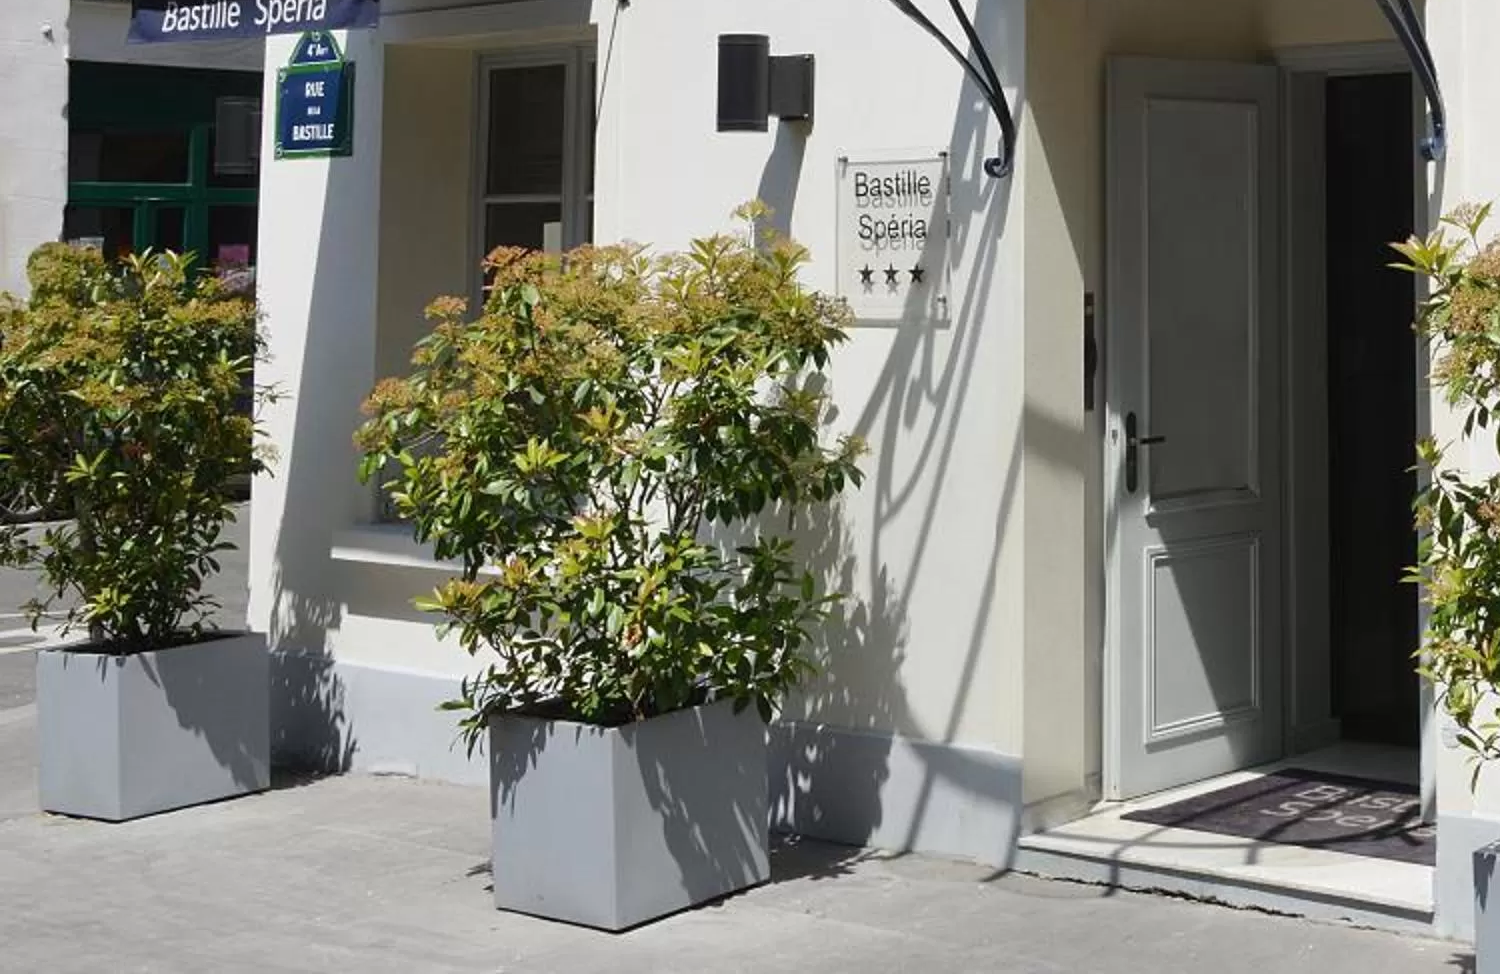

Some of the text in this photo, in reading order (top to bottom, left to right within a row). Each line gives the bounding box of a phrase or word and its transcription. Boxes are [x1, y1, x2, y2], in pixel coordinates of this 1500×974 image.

[305, 81, 325, 98] RUE
[292, 123, 335, 141] BASTILLE
[854, 170, 931, 197] Bastille
[858, 213, 928, 245] Spéria
